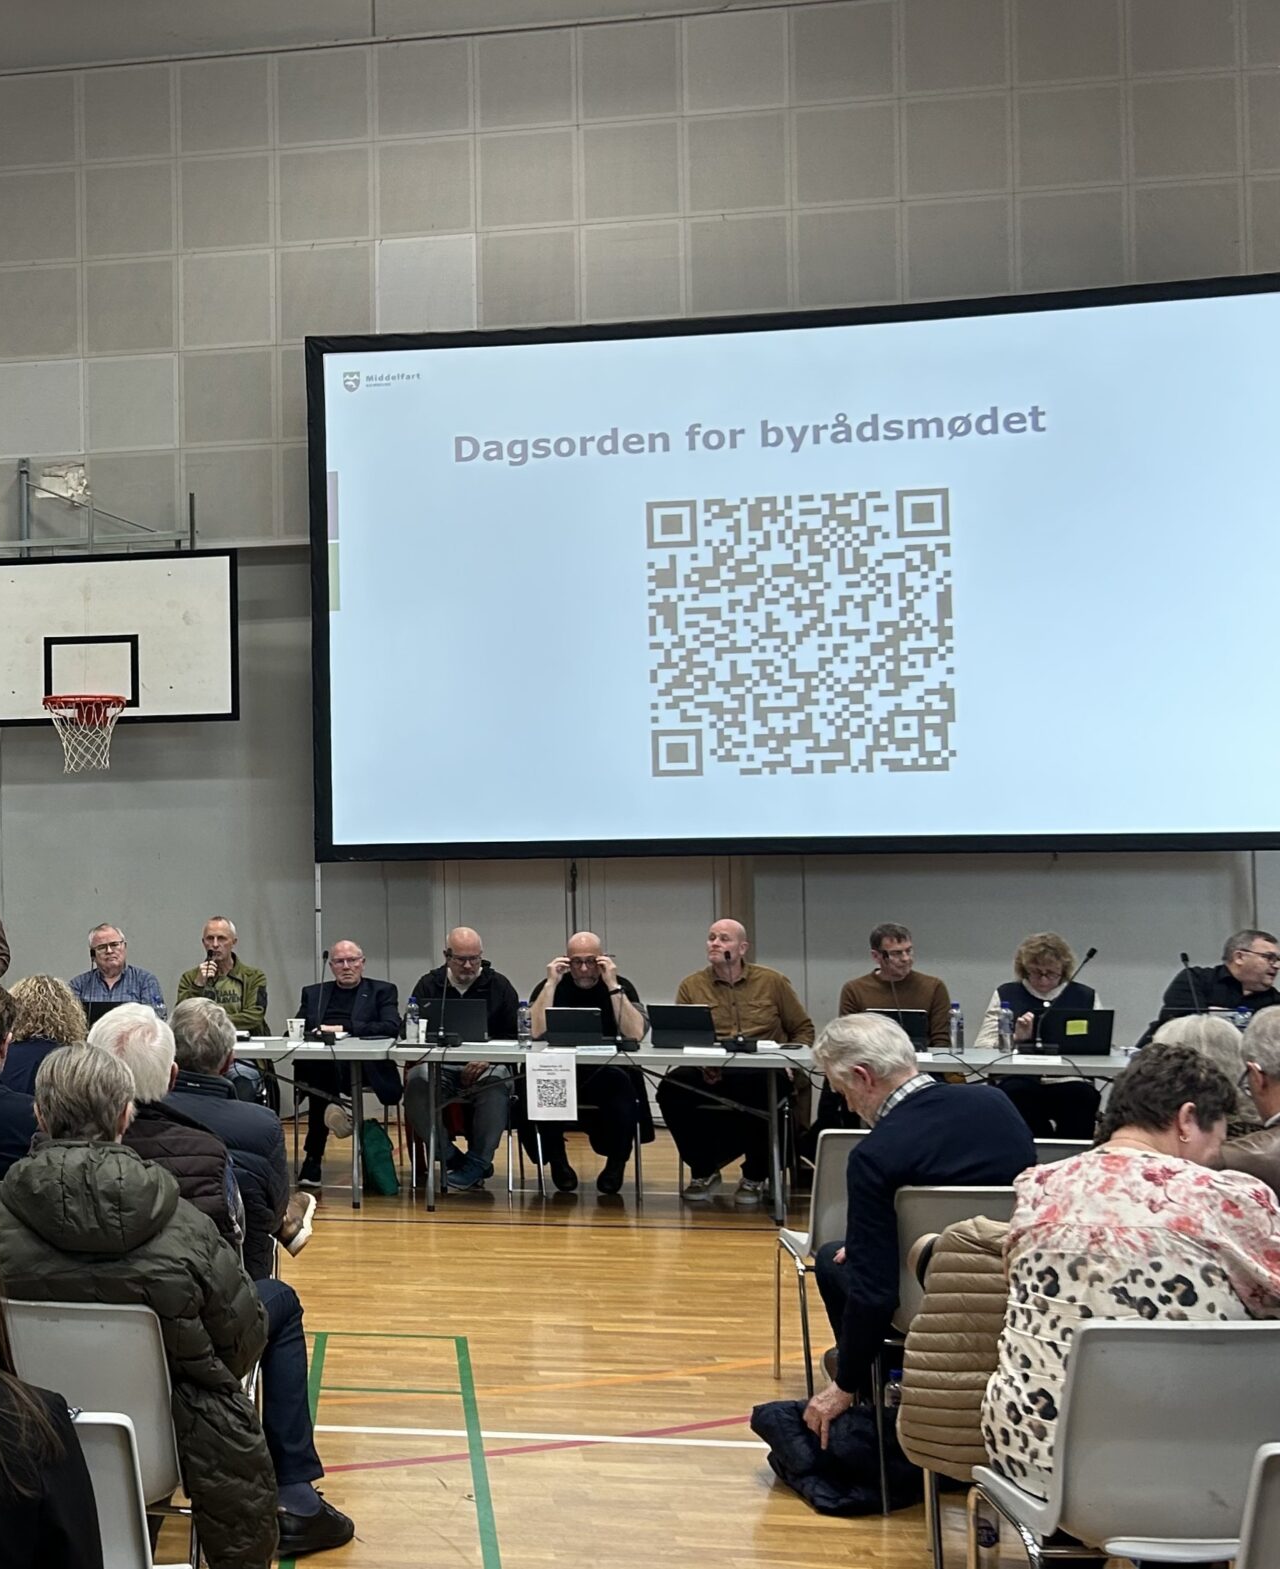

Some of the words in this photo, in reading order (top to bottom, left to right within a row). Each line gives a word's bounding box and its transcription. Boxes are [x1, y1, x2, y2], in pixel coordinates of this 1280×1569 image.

[365, 373, 421, 382] Middelfart
[454, 427, 671, 466] Dagsorden
[685, 423, 746, 452] for
[761, 405, 1047, 453] byrådsmødet
